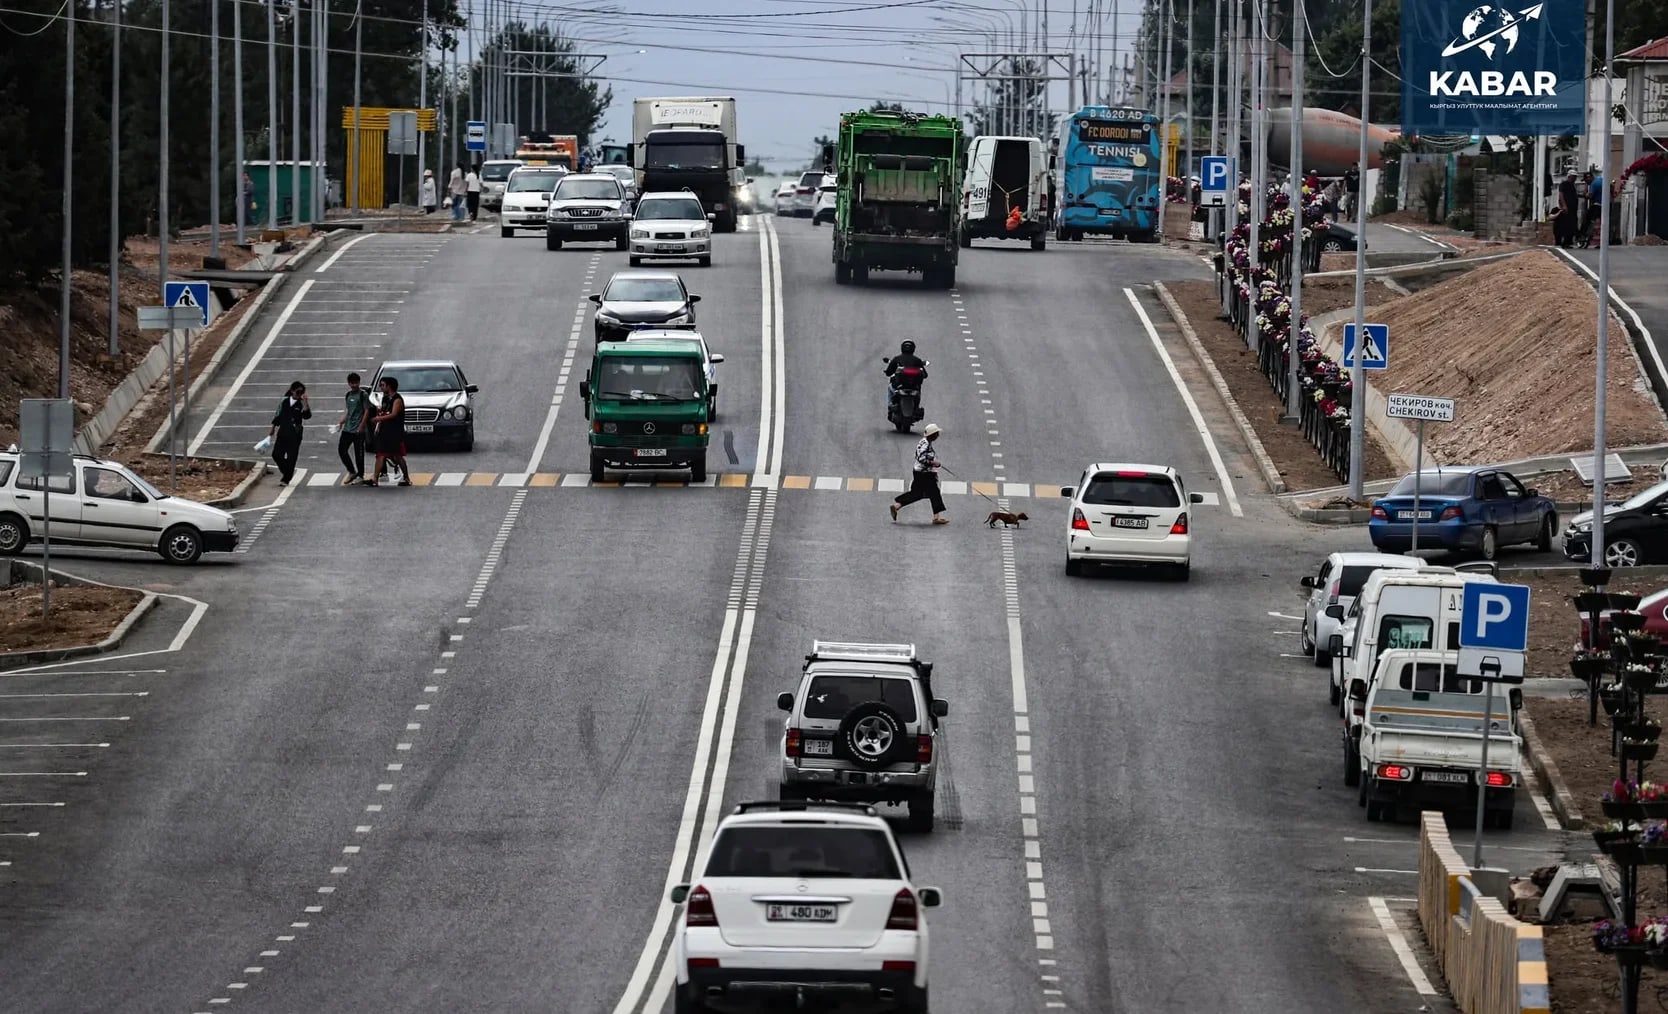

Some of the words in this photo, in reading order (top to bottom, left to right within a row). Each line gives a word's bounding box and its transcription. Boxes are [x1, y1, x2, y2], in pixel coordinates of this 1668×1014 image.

[1099, 110, 1125, 119] 4620
[1127, 111, 1143, 120] AD
[1088, 127, 1098, 137] FC
[1390, 396, 1434, 408] ЧЕКИРОВ
[1389, 406, 1436, 418] CHEKIROV
[1437, 411, 1449, 419] st.
[1476, 592, 1512, 639] P
